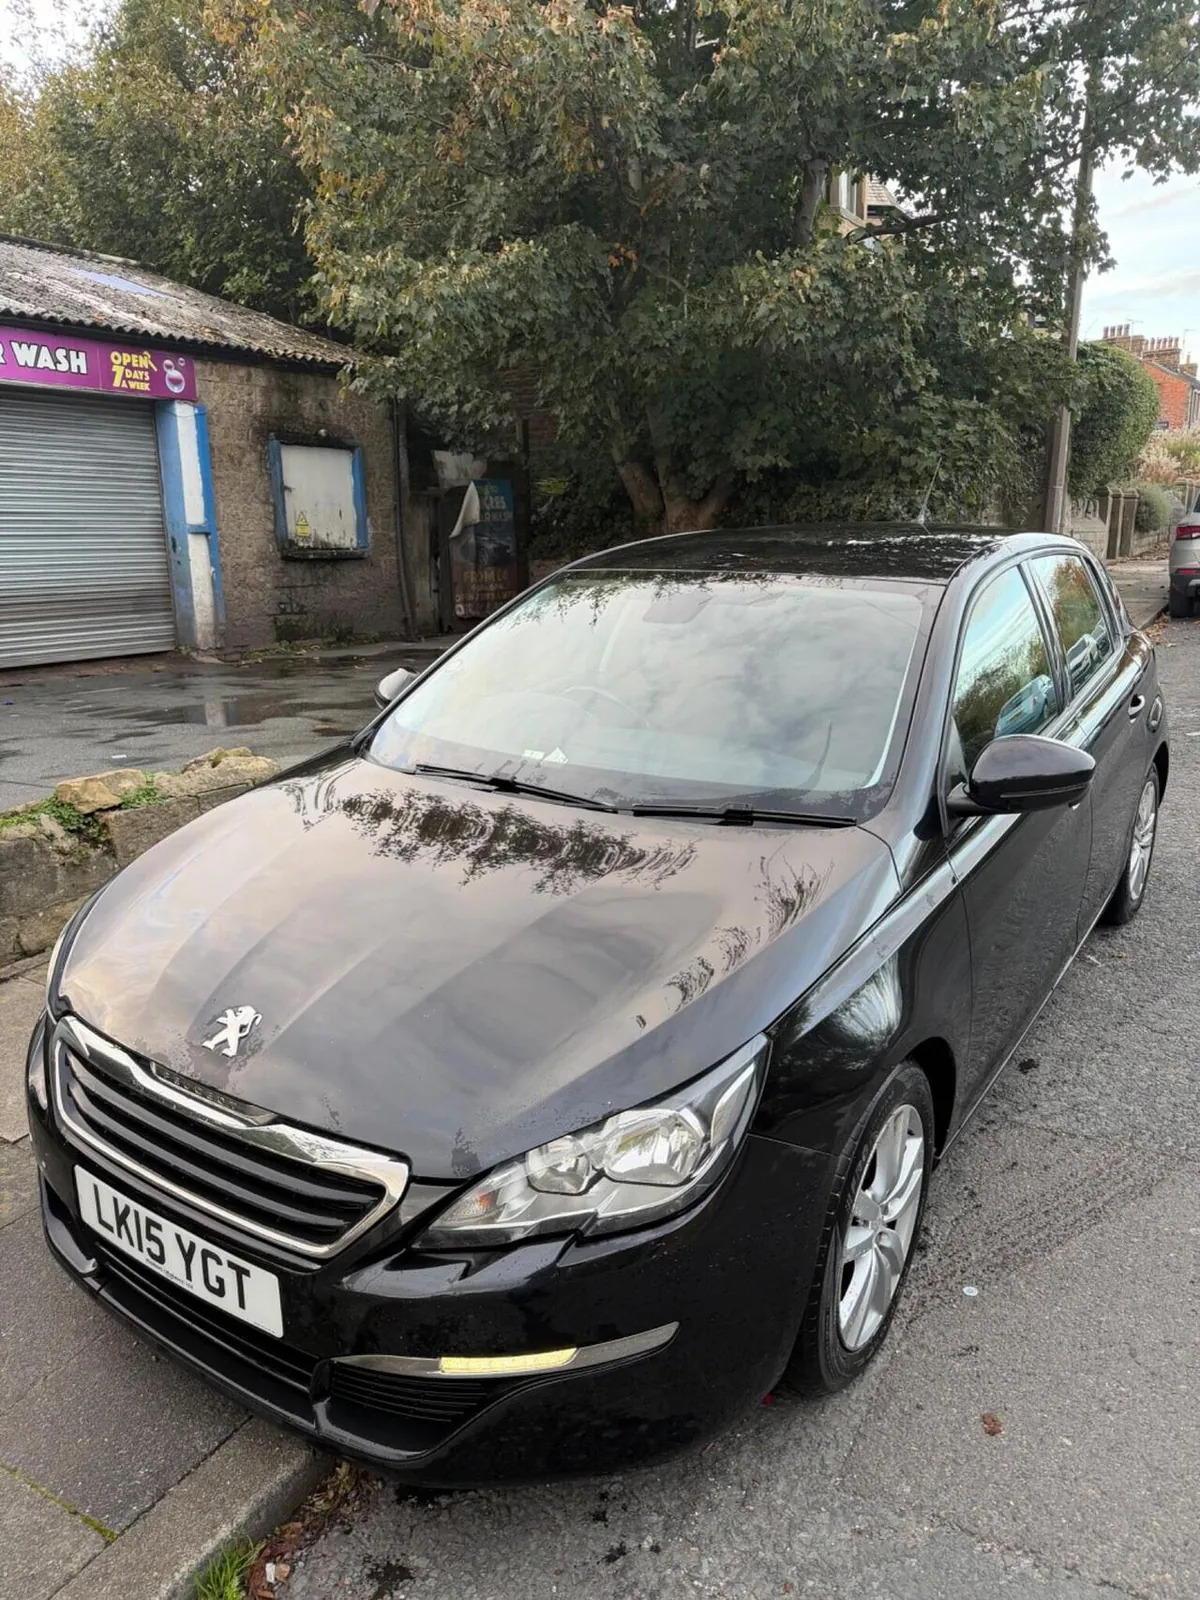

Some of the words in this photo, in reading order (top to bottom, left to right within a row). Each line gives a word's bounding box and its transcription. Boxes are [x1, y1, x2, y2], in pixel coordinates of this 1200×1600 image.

[10, 341, 88, 375] WASH
[110, 351, 149, 369] OPEN
[112, 365, 125, 388] 7
[125, 369, 150, 381] DAYS
[121, 380, 128, 389] A
[128, 381, 151, 392] WEEK
[93, 1183, 166, 1266] LK15
[175, 1232, 252, 1311] YGT
